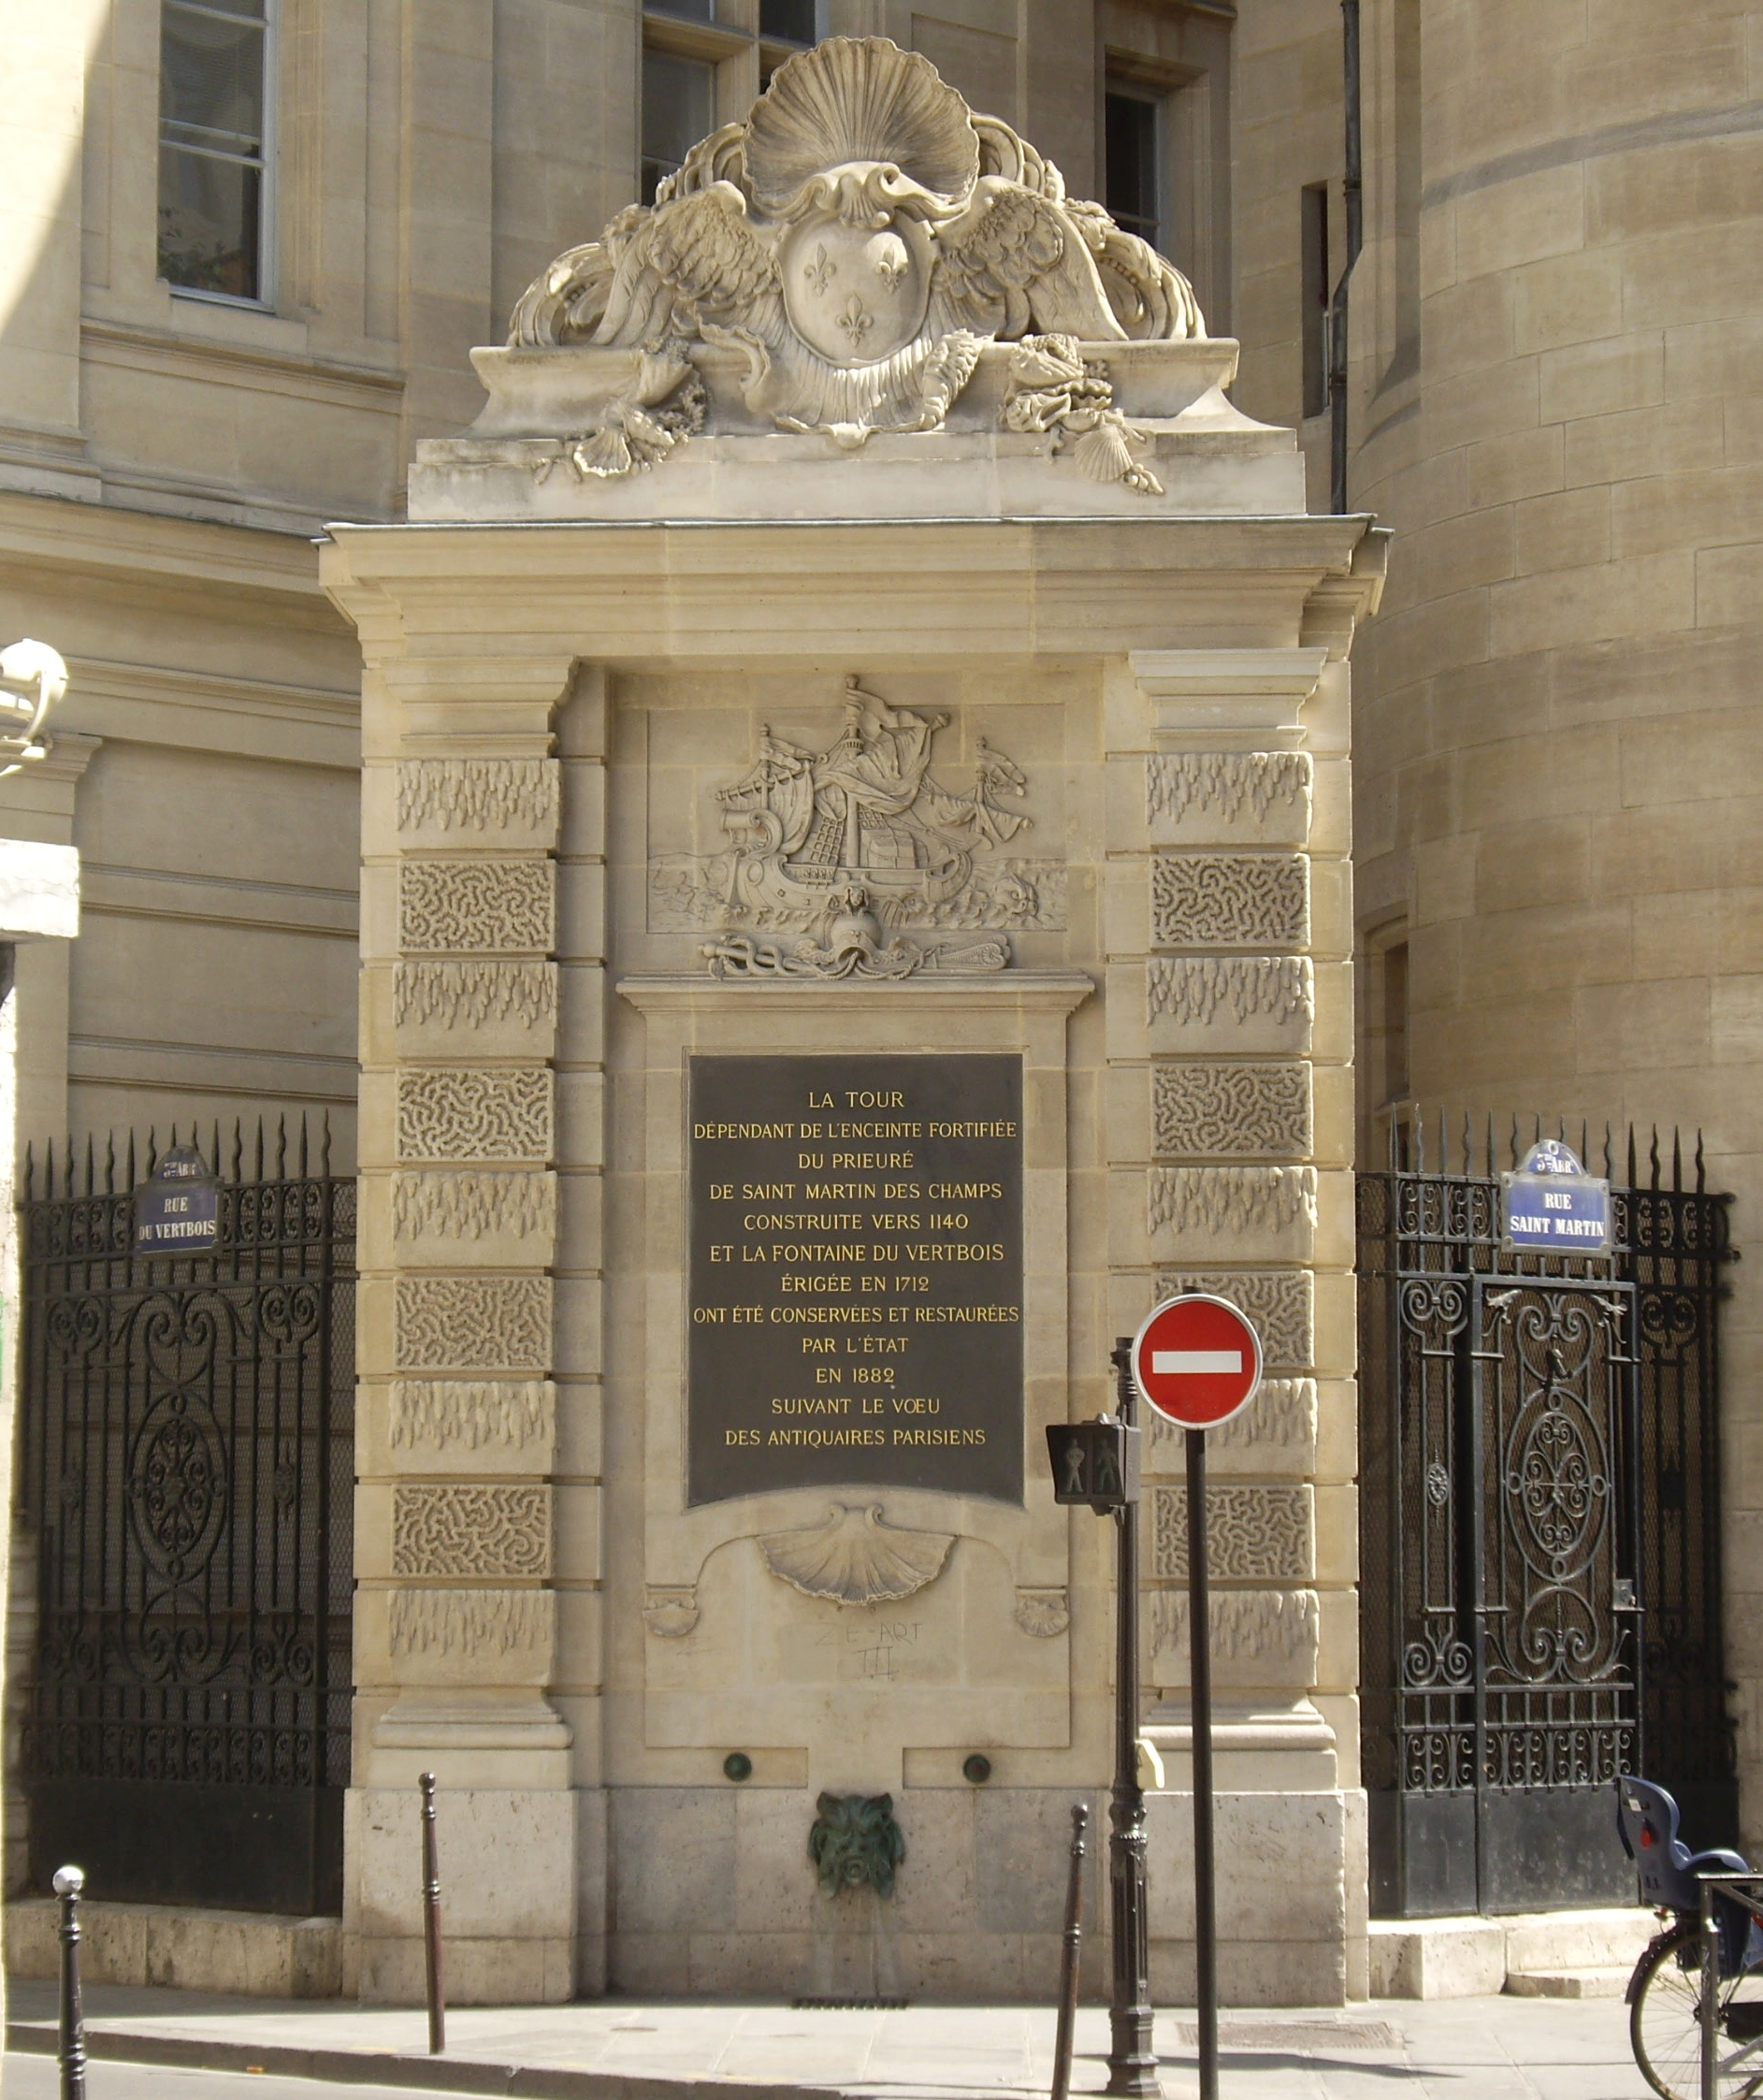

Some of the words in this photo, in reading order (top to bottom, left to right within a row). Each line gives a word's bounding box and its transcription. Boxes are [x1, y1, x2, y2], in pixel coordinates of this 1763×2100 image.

[809, 1092, 834, 1108] LA
[845, 1091, 905, 1108] TOUR
[694, 1121, 795, 1139] DÉPENDANT
[800, 1122, 823, 1138] DE
[828, 1122, 922, 1138] L'ENCEINTE
[929, 1118, 1017, 1138] FORTIFIÉE
[798, 1153, 824, 1169] DU
[831, 1150, 914, 1169] PRIEURÉ
[710, 1183, 734, 1200] DE
[742, 1183, 796, 1200] SAINT
[805, 1183, 876, 1199] MARTIN
[884, 1182, 920, 1199] DES
[928, 1182, 1003, 1199] CHAMPS
[164, 1196, 189, 1213] RUE
[1544, 1193, 1572, 1210] RUE
[138, 1224, 152, 1240] DU
[155, 1220, 215, 1239] VERTBOIS
[744, 1213, 862, 1231] CONSTRUITE
[871, 1213, 921, 1230] VERS
[930, 1213, 969, 1230] 1140
[1510, 1216, 1551, 1234] SAINT
[1555, 1218, 1605, 1238] MARTIN
[710, 1245, 734, 1263] ET
[742, 1245, 766, 1262] LA
[772, 1244, 866, 1262] FONTAINE
[873, 1244, 899, 1262] DU
[904, 1243, 1004, 1262] VERTBOIS
[781, 1272, 852, 1293] ÉRIGÉE
[860, 1276, 886, 1292] EN
[895, 1276, 929, 1292] 1712
[693, 1307, 728, 1324] ONT
[732, 1304, 764, 1324] ÉTÉ
[770, 1304, 883, 1324] CONSERVÉES
[889, 1307, 910, 1323] ET
[915, 1303, 1019, 1323] RESTAURÉES
[802, 1338, 836, 1354] PAR
[846, 1334, 909, 1354] L'ÉTAT
[816, 1368, 842, 1383] EN
[853, 1367, 895, 1384] 1882
[772, 1398, 852, 1414] SUIVANT
[862, 1398, 885, 1414] LE
[891, 1398, 940, 1414] VŒU
[725, 1429, 760, 1446] DES
[767, 1429, 885, 1449] ANTIQUAIRES
[892, 1428, 986, 1445] PARISIENS
